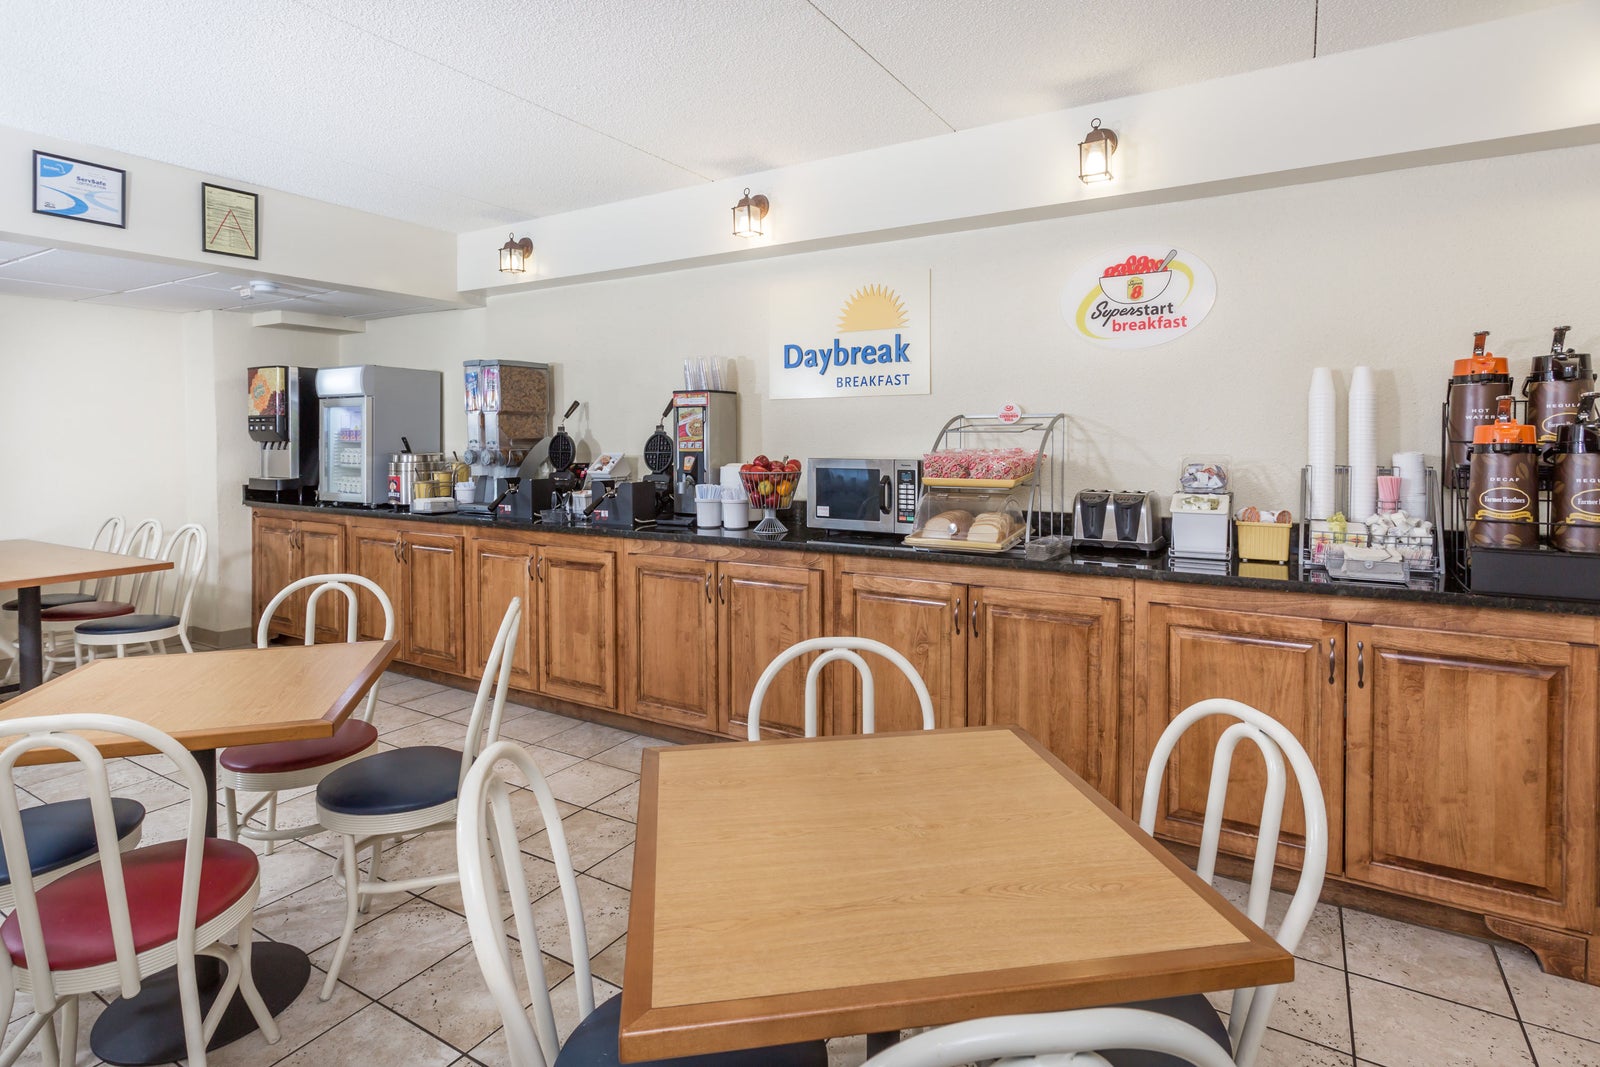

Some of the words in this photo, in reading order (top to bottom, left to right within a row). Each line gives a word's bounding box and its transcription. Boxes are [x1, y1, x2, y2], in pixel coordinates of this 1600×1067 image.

[76, 175, 107, 186] ServSafe
[210, 208, 252, 251] A
[1130, 285, 1144, 299] 8
[1091, 301, 1174, 327] Superstart
[1112, 315, 1188, 332] breakfast
[784, 333, 910, 376] Daybreak
[836, 374, 910, 388] BREAKFAST
[1502, 496, 1526, 504] Brothers
